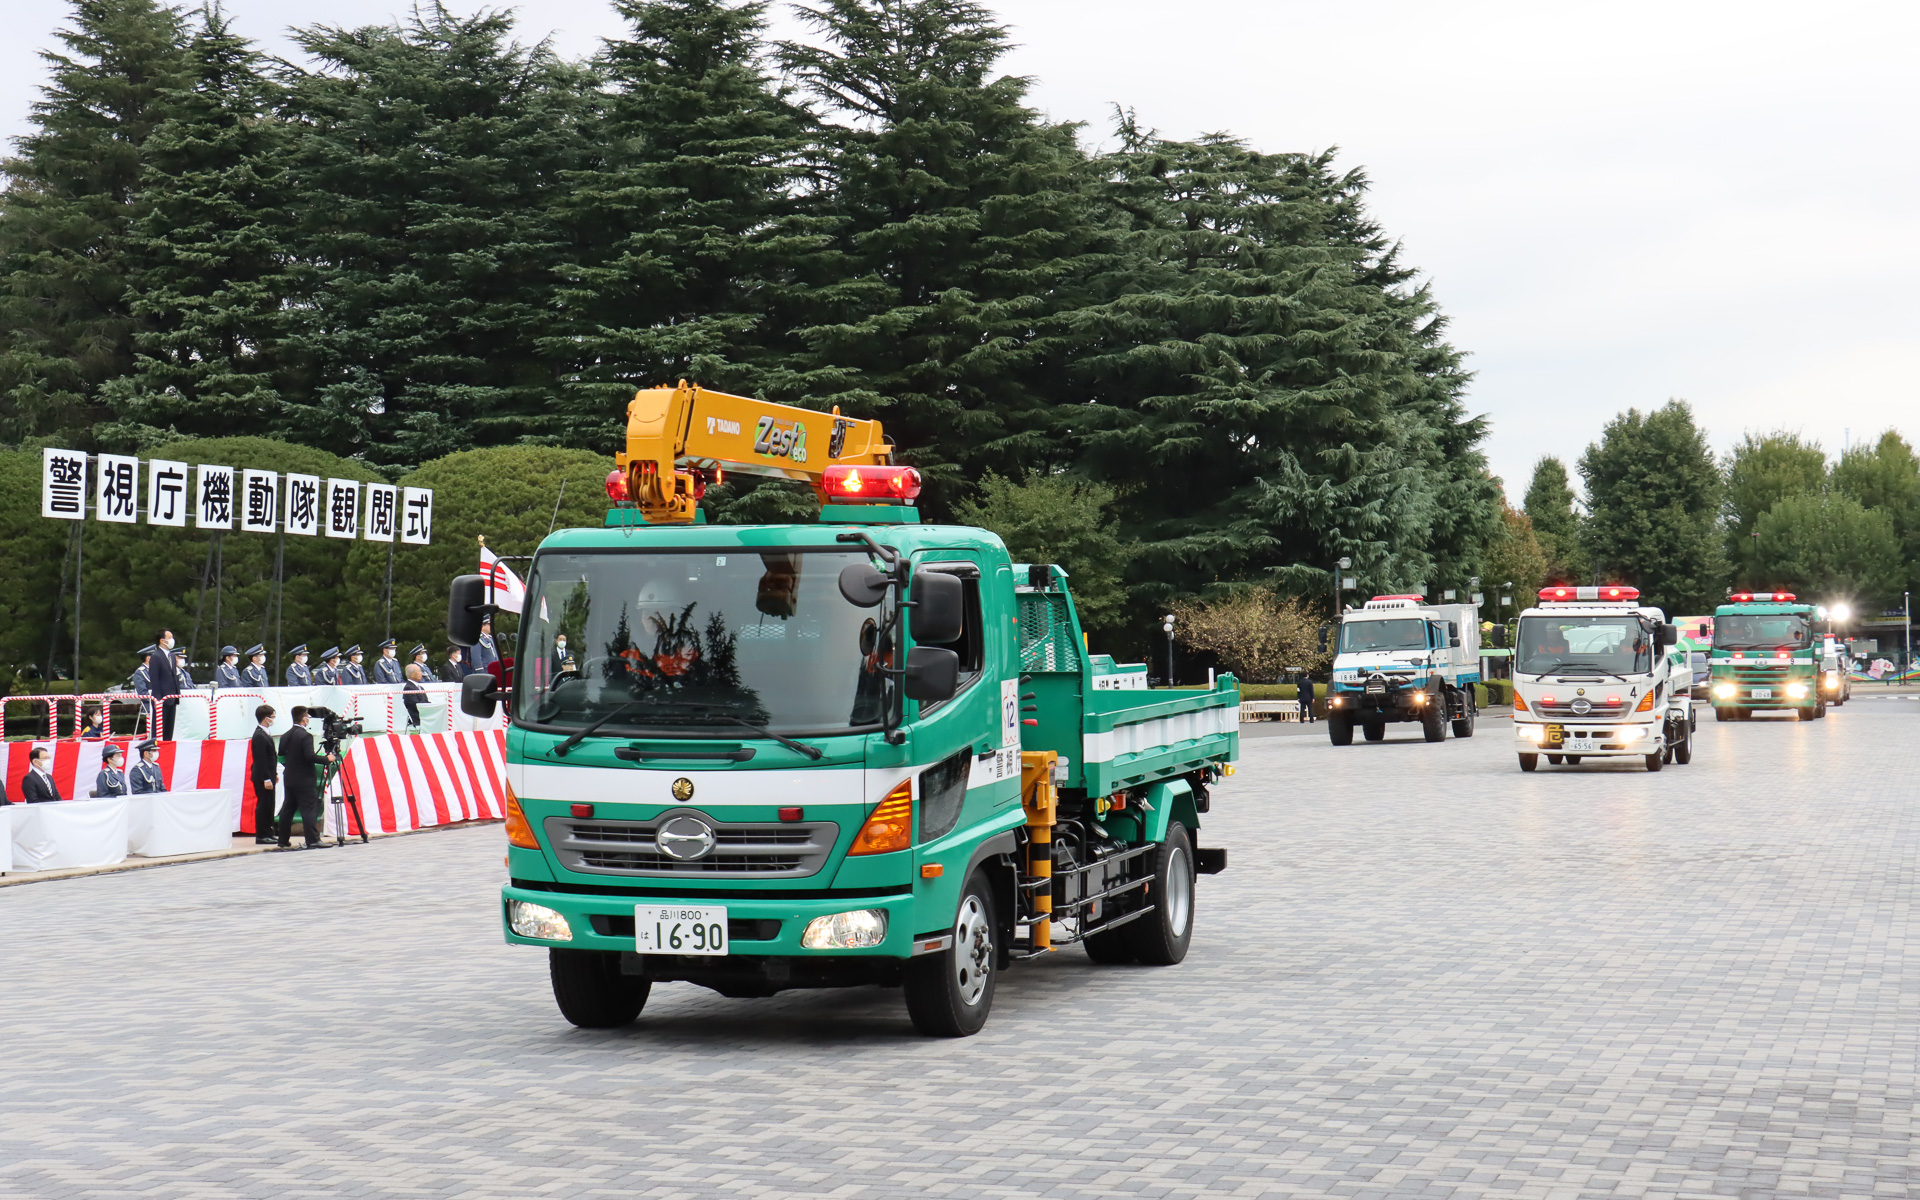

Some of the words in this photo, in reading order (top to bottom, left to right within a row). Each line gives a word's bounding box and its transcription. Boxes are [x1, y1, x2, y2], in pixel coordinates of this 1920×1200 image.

[716, 418, 741, 436] TADANO
[753, 415, 800, 457] Zest
[792, 446, 807, 463] eco
[49, 455, 430, 541] 警視庁機動隊観閲式
[1630, 686, 1638, 699] 4
[1006, 701, 1015, 728] 12
[1544, 724, 1563, 743] 危
[656, 922, 722, 950] 16-90
